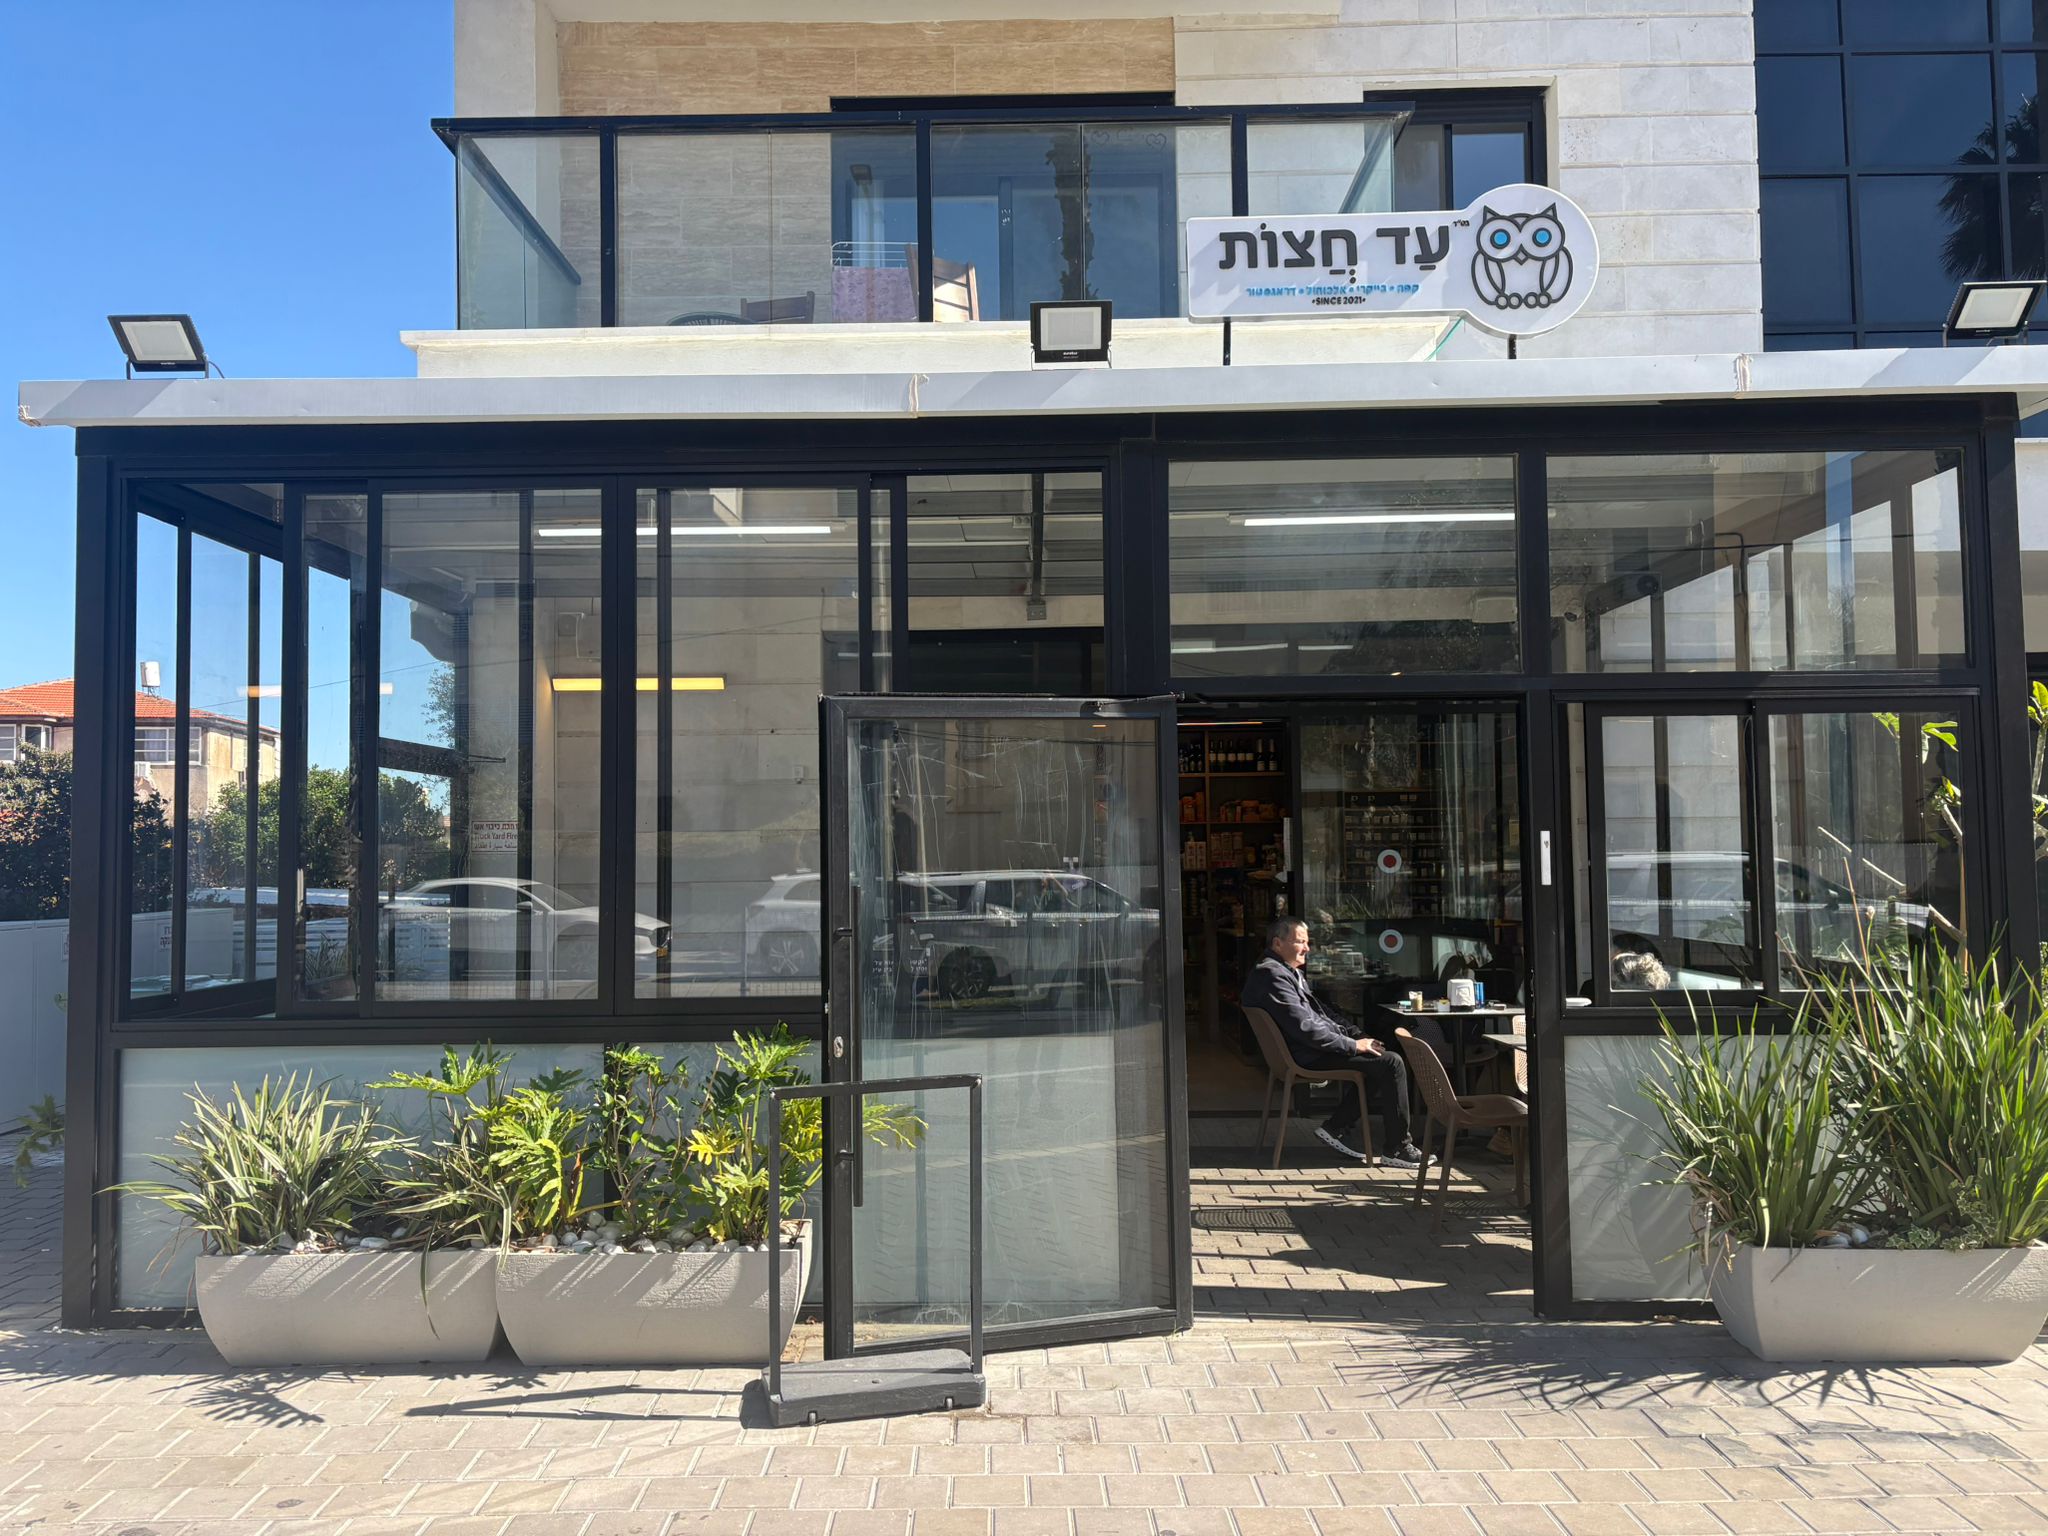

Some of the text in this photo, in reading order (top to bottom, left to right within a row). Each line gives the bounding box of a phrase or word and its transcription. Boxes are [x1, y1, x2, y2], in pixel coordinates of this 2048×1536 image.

[1396, 284, 1419, 295] קפה
[1343, 296, 1362, 304] 2021
[491, 832, 506, 840] Yard
